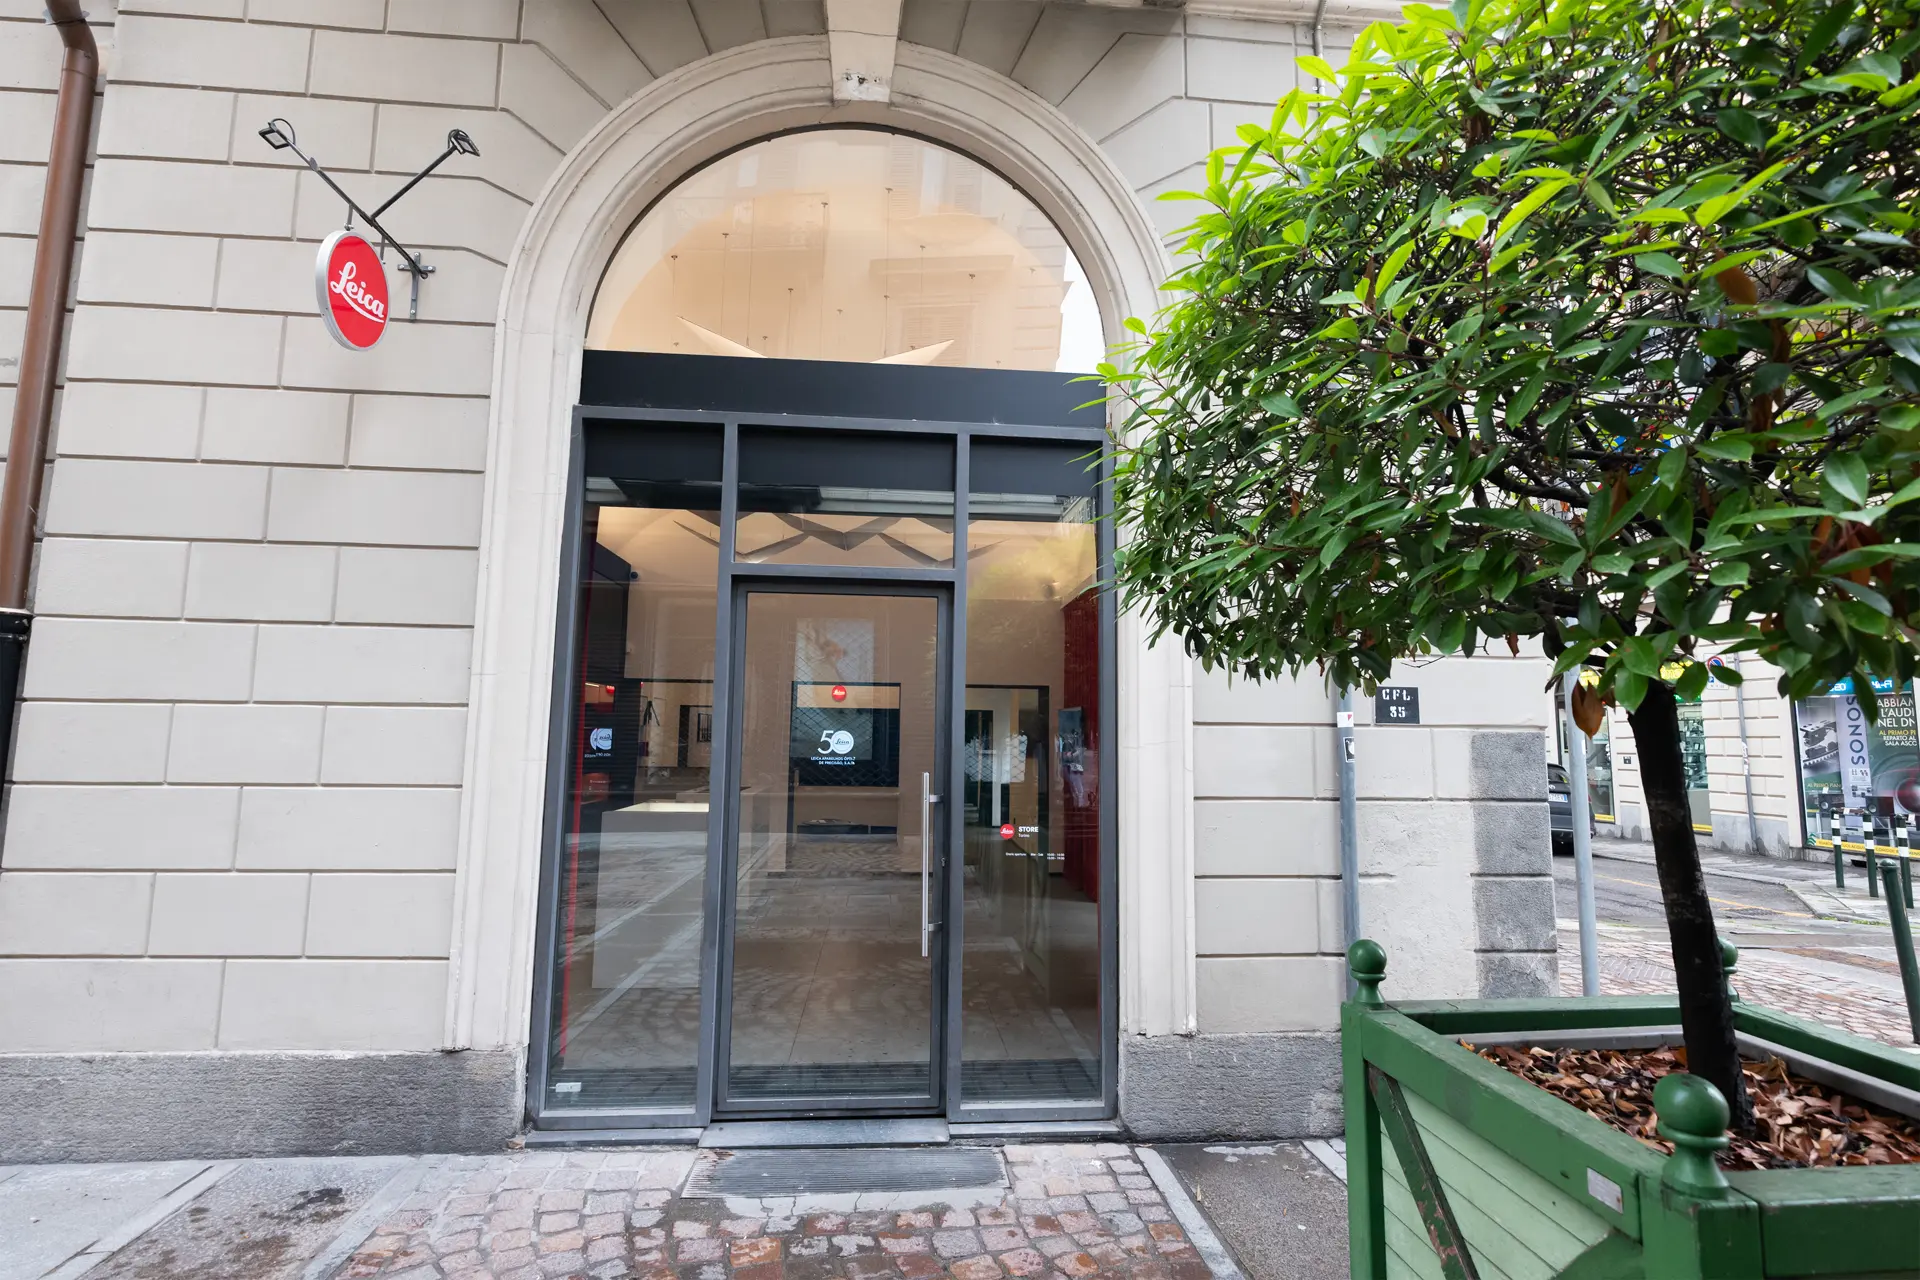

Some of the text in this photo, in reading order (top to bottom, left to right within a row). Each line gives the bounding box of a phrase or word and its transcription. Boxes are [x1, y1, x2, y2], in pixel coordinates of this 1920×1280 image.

[330, 261, 385, 323] Leica
[1389, 706, 1405, 718] 35
[1846, 696, 1866, 765] SONOS
[1877, 718, 1898, 727] NEL
